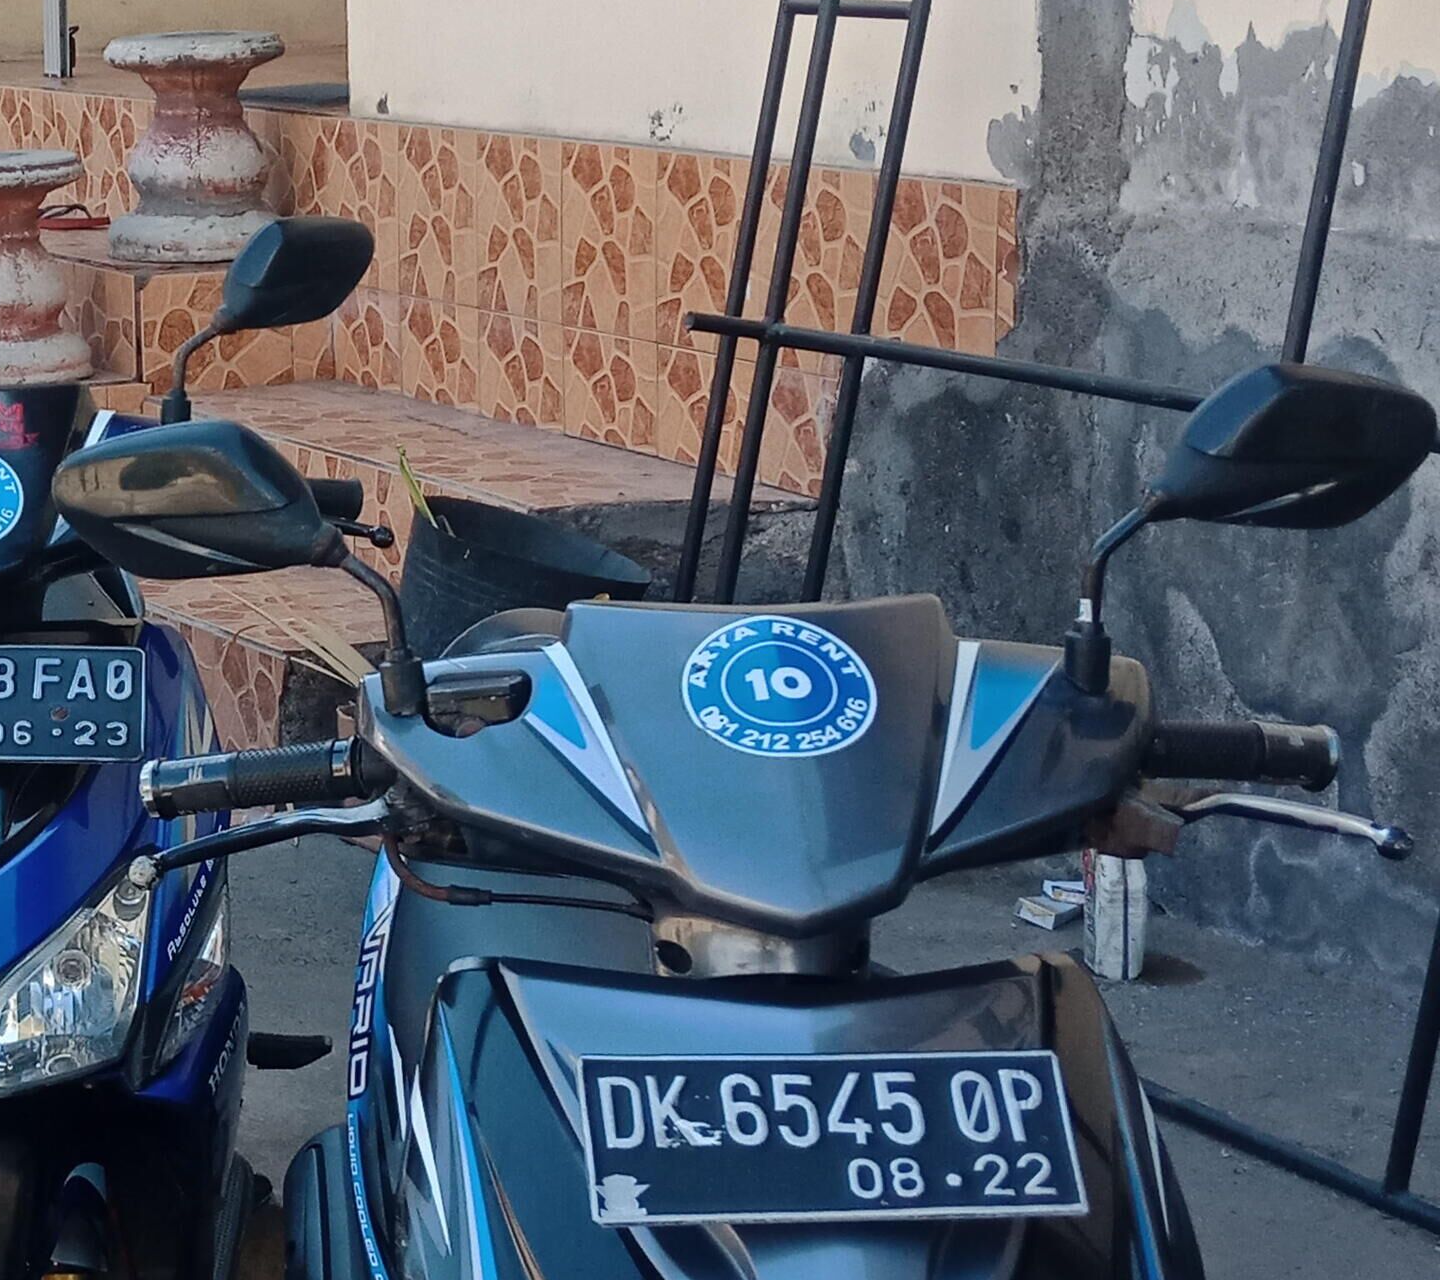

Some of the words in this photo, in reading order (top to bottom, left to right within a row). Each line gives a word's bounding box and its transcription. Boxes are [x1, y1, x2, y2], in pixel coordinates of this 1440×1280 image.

[688, 625, 760, 689] ARYA
[770, 621, 863, 679] RENT
[744, 666, 813, 701] 10
[699, 705, 737, 737] 081
[740, 727, 791, 750] 212
[795, 725, 844, 750] 254
[836, 697, 869, 732] 616
[349, 900, 396, 1097] VARIO
[596, 1074, 690, 1149] DK
[720, 1071, 926, 1148] 6545
